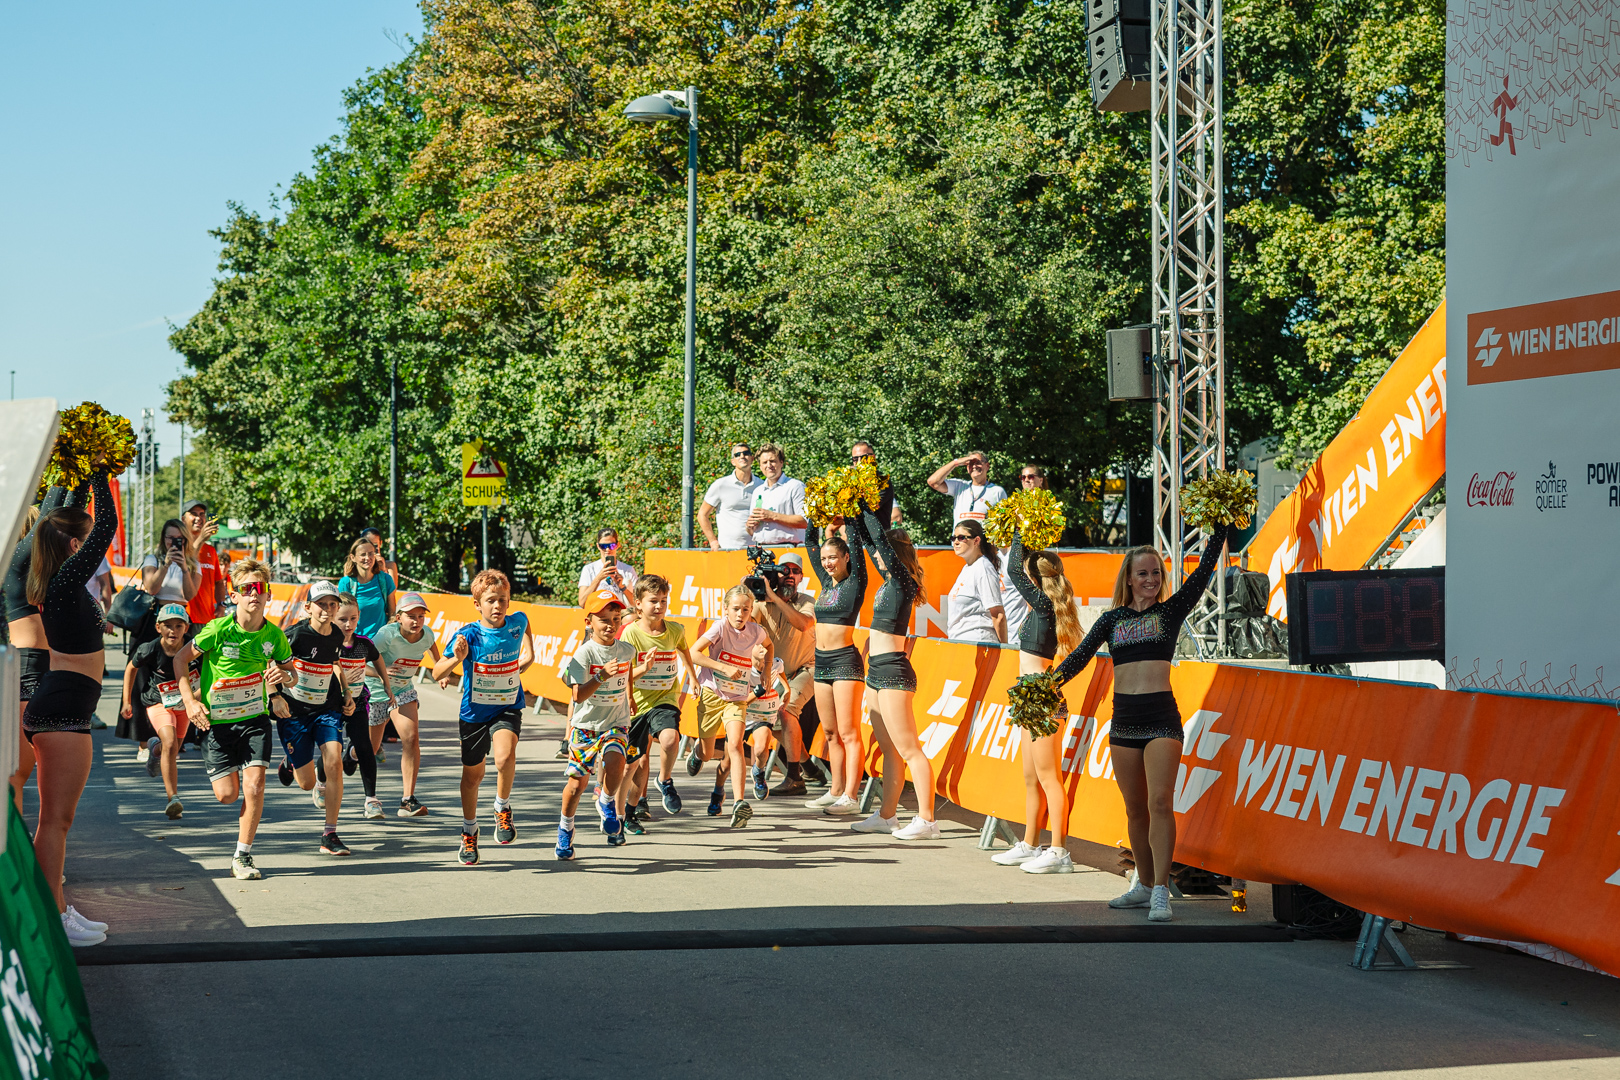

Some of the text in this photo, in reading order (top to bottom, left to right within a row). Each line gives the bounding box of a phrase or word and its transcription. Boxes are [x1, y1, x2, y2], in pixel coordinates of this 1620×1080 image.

[1508, 327, 1551, 356] WIEN
[1587, 462, 1620, 484] POW
[465, 485, 508, 498] SCHUE
[1467, 471, 1517, 508] Coca-Cola
[1309, 447, 1379, 549] WIEN
[1535, 494, 1567, 513] QUELLE
[487, 651, 503, 662] TRI
[665, 664, 676, 672] 40
[318, 679, 324, 687] 5
[508, 677, 514, 686] 6
[617, 677, 625, 687] 62
[244, 688, 256, 698] 52
[767, 701, 776, 709] 18
[1234, 738, 1566, 868] WIEN ENERGIE
